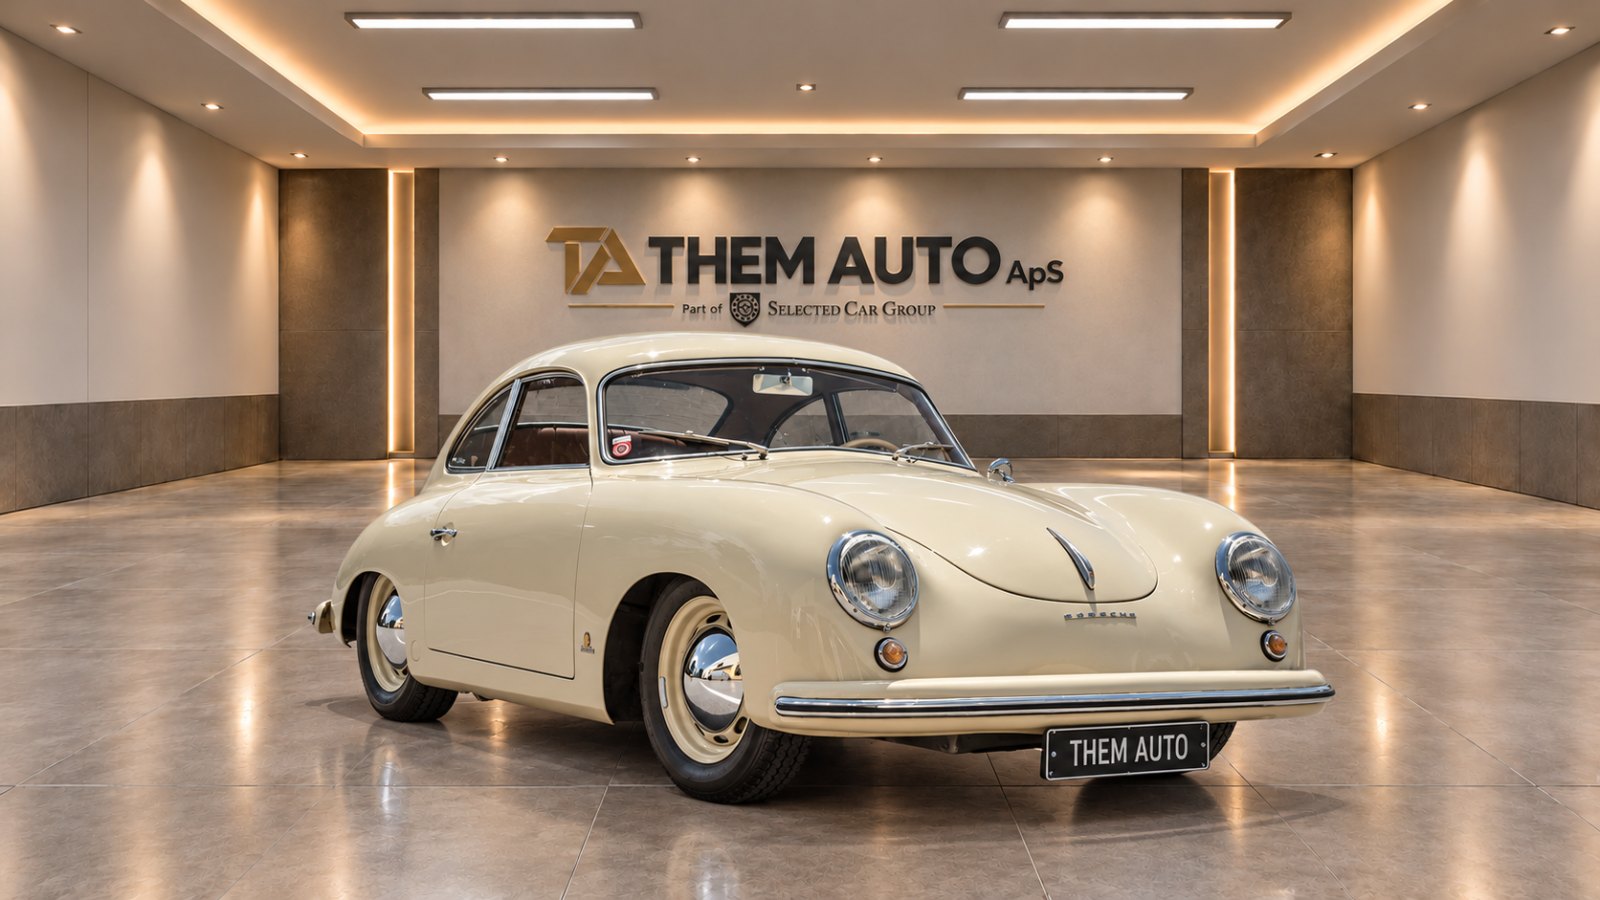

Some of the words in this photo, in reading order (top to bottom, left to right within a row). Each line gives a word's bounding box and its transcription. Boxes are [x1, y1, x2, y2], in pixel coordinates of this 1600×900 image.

[545, 226, 646, 295] TA
[648, 236, 815, 285] THEM
[828, 236, 1001, 285] AUTO
[1006, 260, 1064, 290] ApS
[682, 303, 706, 314] Part
[710, 303, 723, 314] of
[844, 301, 878, 316] CAR
[882, 301, 936, 316] GROUP
[1069, 736, 1128, 766] THEM
[1134, 733, 1188, 762] AUTO
